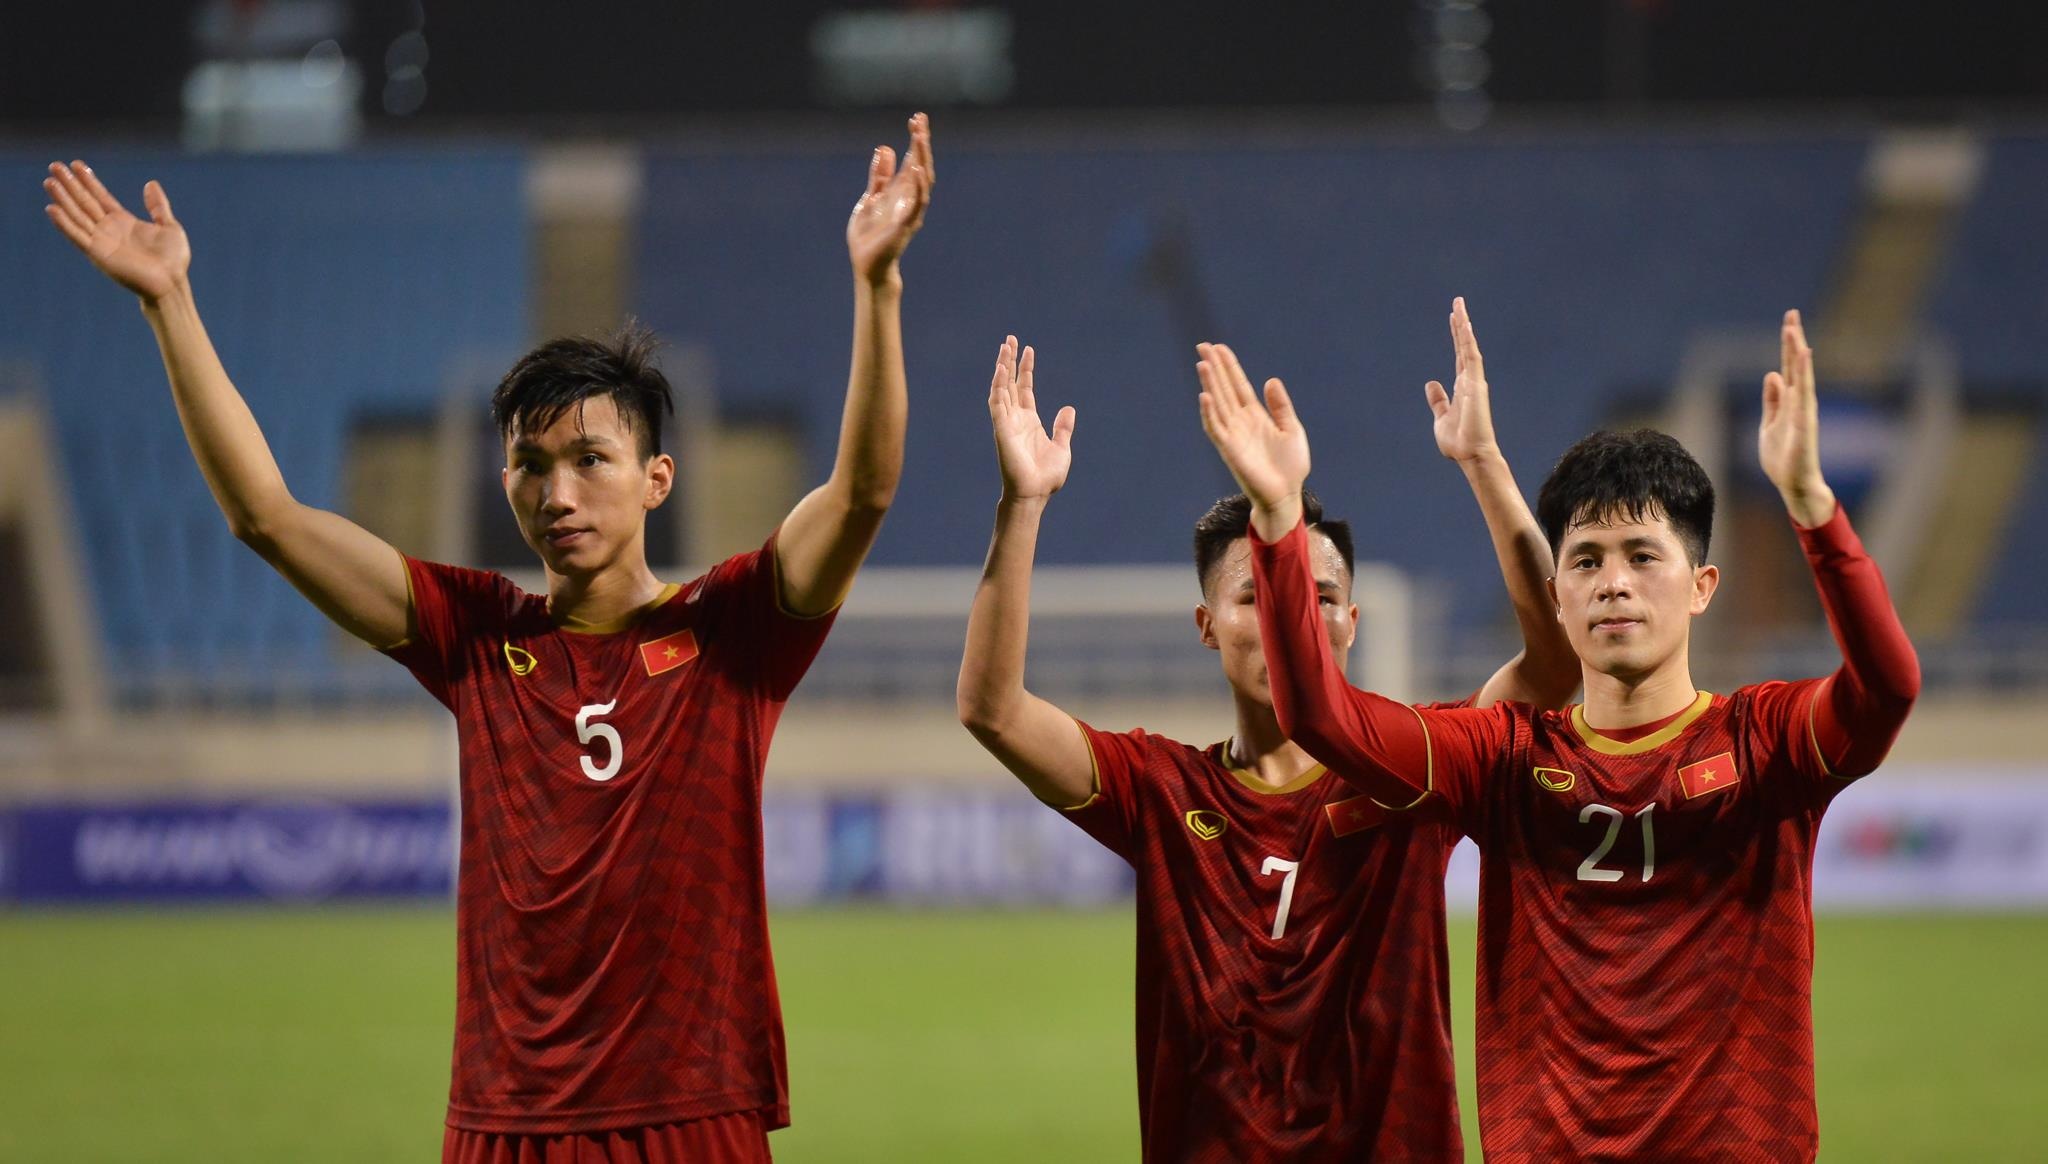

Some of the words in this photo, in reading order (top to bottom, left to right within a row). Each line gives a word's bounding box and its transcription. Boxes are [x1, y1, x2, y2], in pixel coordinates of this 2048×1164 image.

[575, 698, 623, 781] 5
[1576, 801, 1656, 882] 21
[1260, 855, 1299, 940] 7
